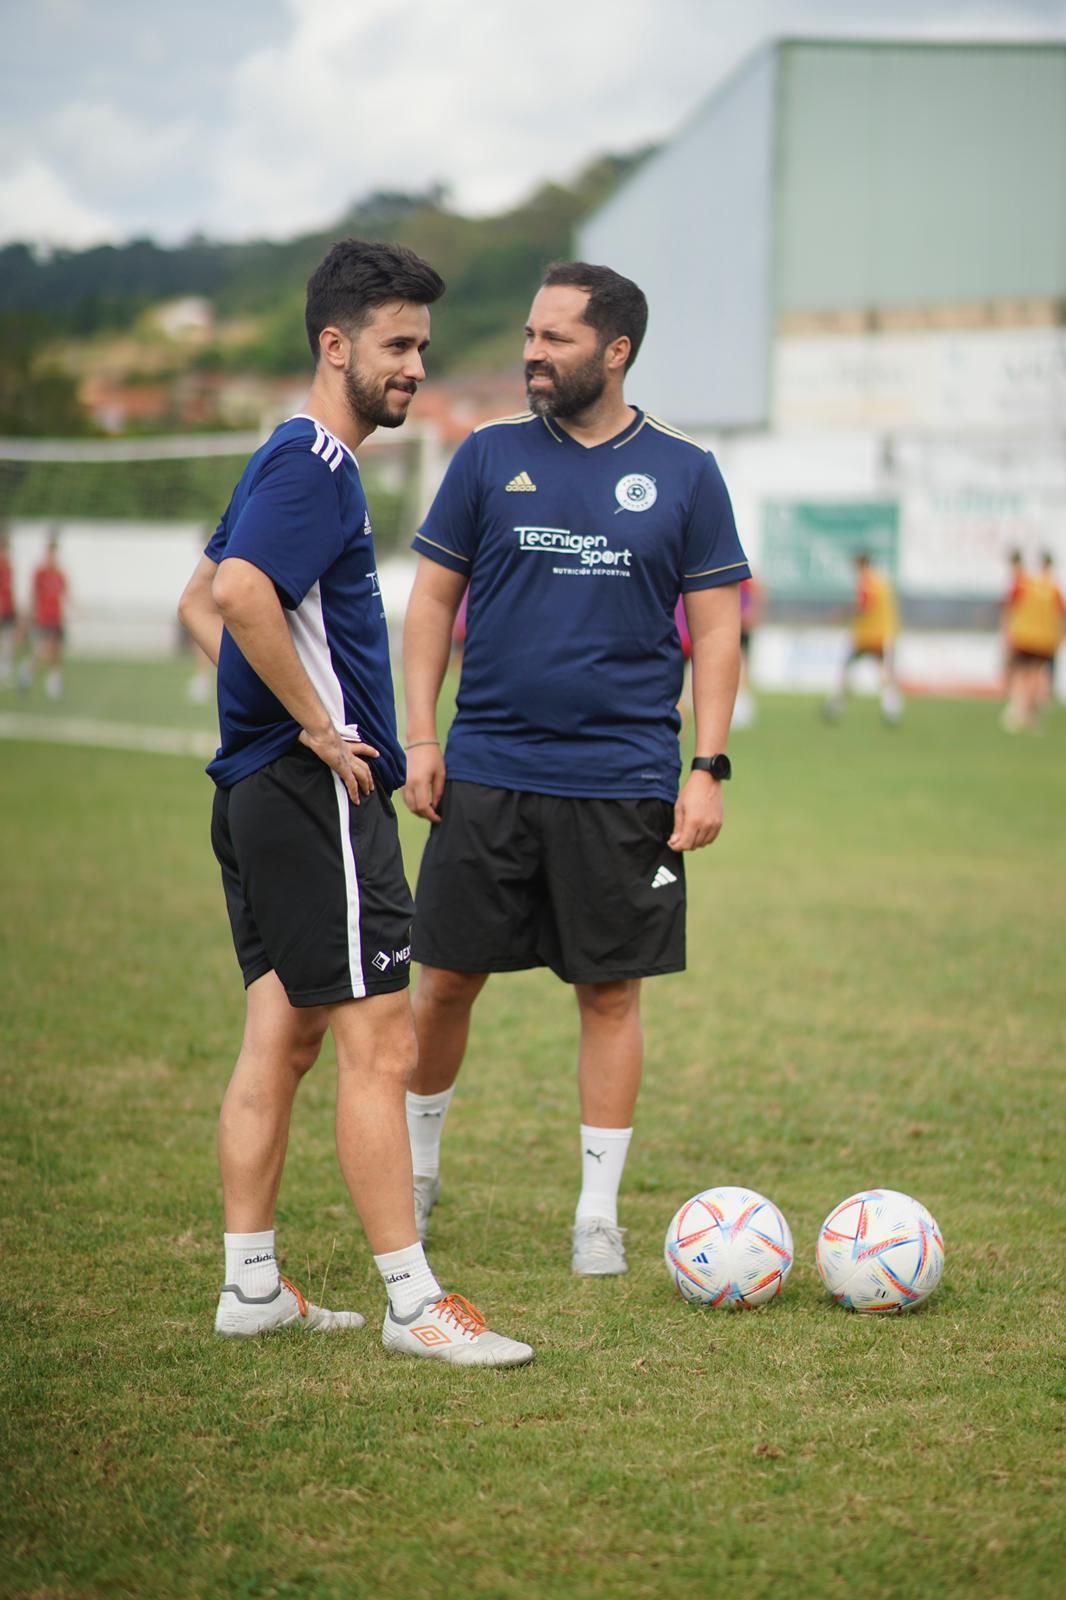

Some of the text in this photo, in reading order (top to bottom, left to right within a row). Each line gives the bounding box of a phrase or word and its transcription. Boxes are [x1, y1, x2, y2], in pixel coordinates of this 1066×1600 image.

[513, 526, 608, 554] Tecnigen
[580, 549, 633, 567] sport
[552, 567, 631, 577] NUTRICIÓN DEPORTIVA
